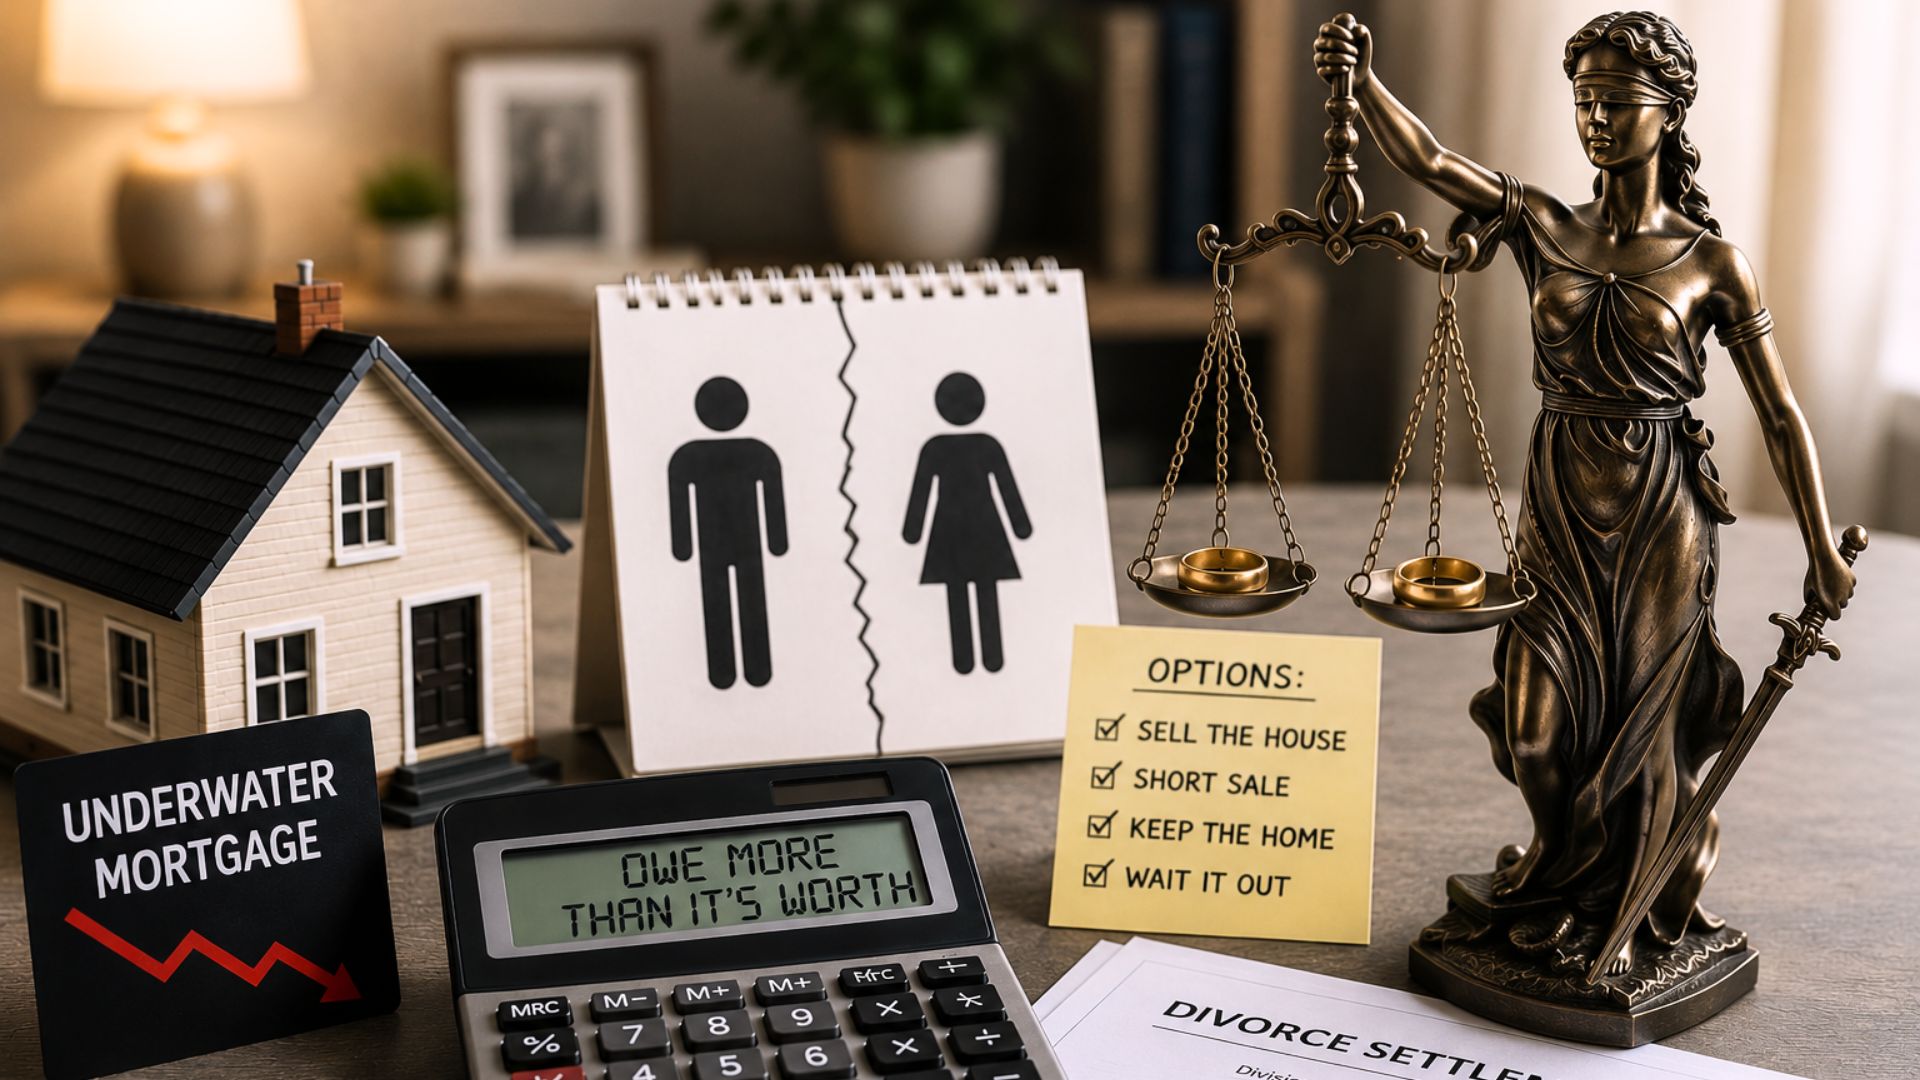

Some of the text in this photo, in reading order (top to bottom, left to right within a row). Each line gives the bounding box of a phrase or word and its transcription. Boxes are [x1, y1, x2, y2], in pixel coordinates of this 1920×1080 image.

[1147, 657, 1305, 689] OPTIONS:
[1137, 720, 1347, 752] SELL THE HOUSE
[1133, 768, 1290, 798] SHORT SALE
[62, 758, 338, 843] UNDERWATER
[1129, 817, 1335, 850] KEEP THE HOME
[94, 819, 322, 899] MORTGAGE
[621, 833, 840, 890] OWE MORE
[1125, 866, 1291, 897] WAIT IT OUT
[561, 870, 918, 938] THAN IT'S WORTH
[686, 985, 730, 1001] M+
[768, 976, 812, 993] M+
[511, 1000, 560, 1018] MRC
[791, 1008, 814, 1027] 9
[622, 1023, 644, 1045] 7
[708, 1015, 730, 1035] 8
[1163, 1000, 1359, 1053] DIVORCE
[523, 1033, 561, 1055] %
[804, 1046, 829, 1067] 6
[632, 1064, 656, 1080] 4
[719, 1054, 742, 1076] 5
